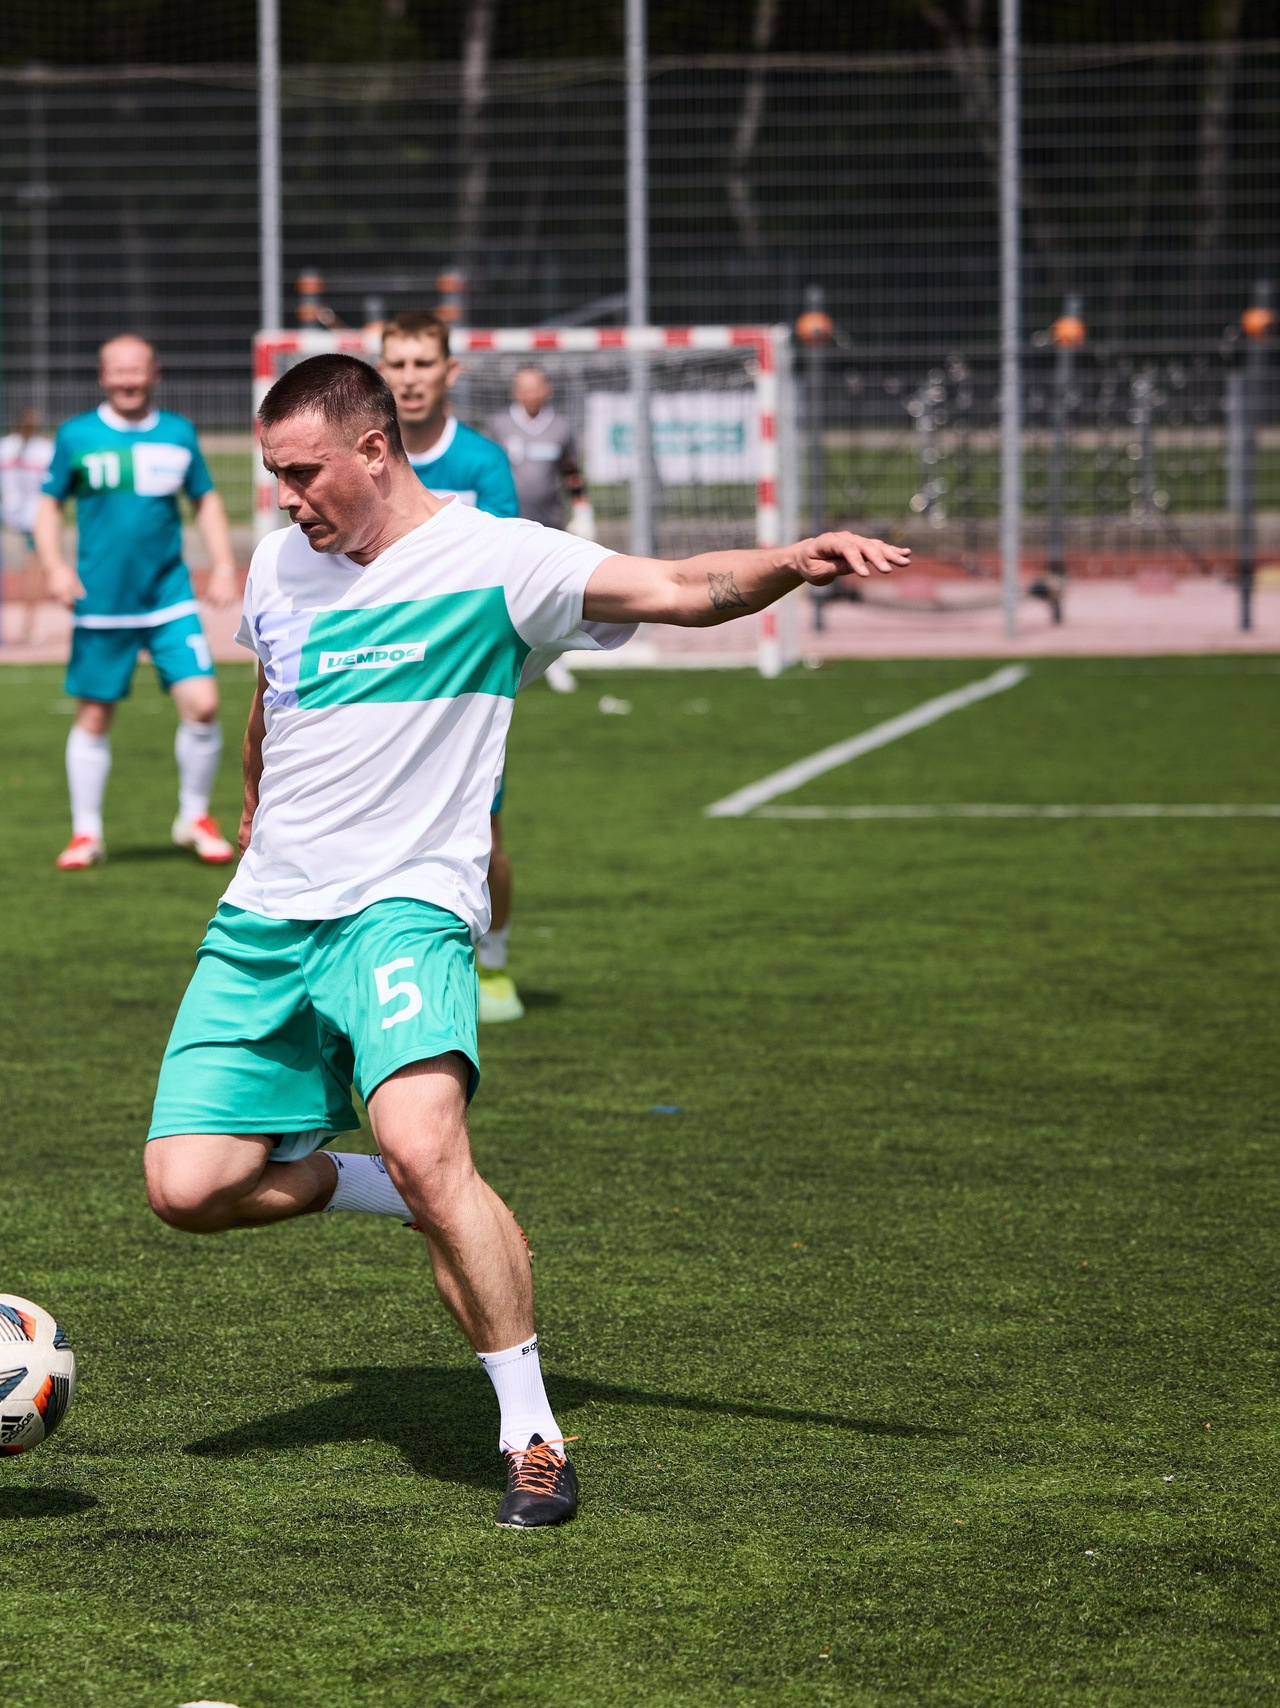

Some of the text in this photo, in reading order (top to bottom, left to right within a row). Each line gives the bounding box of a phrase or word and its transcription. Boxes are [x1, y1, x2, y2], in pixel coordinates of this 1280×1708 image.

[81, 451, 120, 490] 11
[373, 956, 423, 1030] 5
[2, 1411, 35, 1444] adidas
